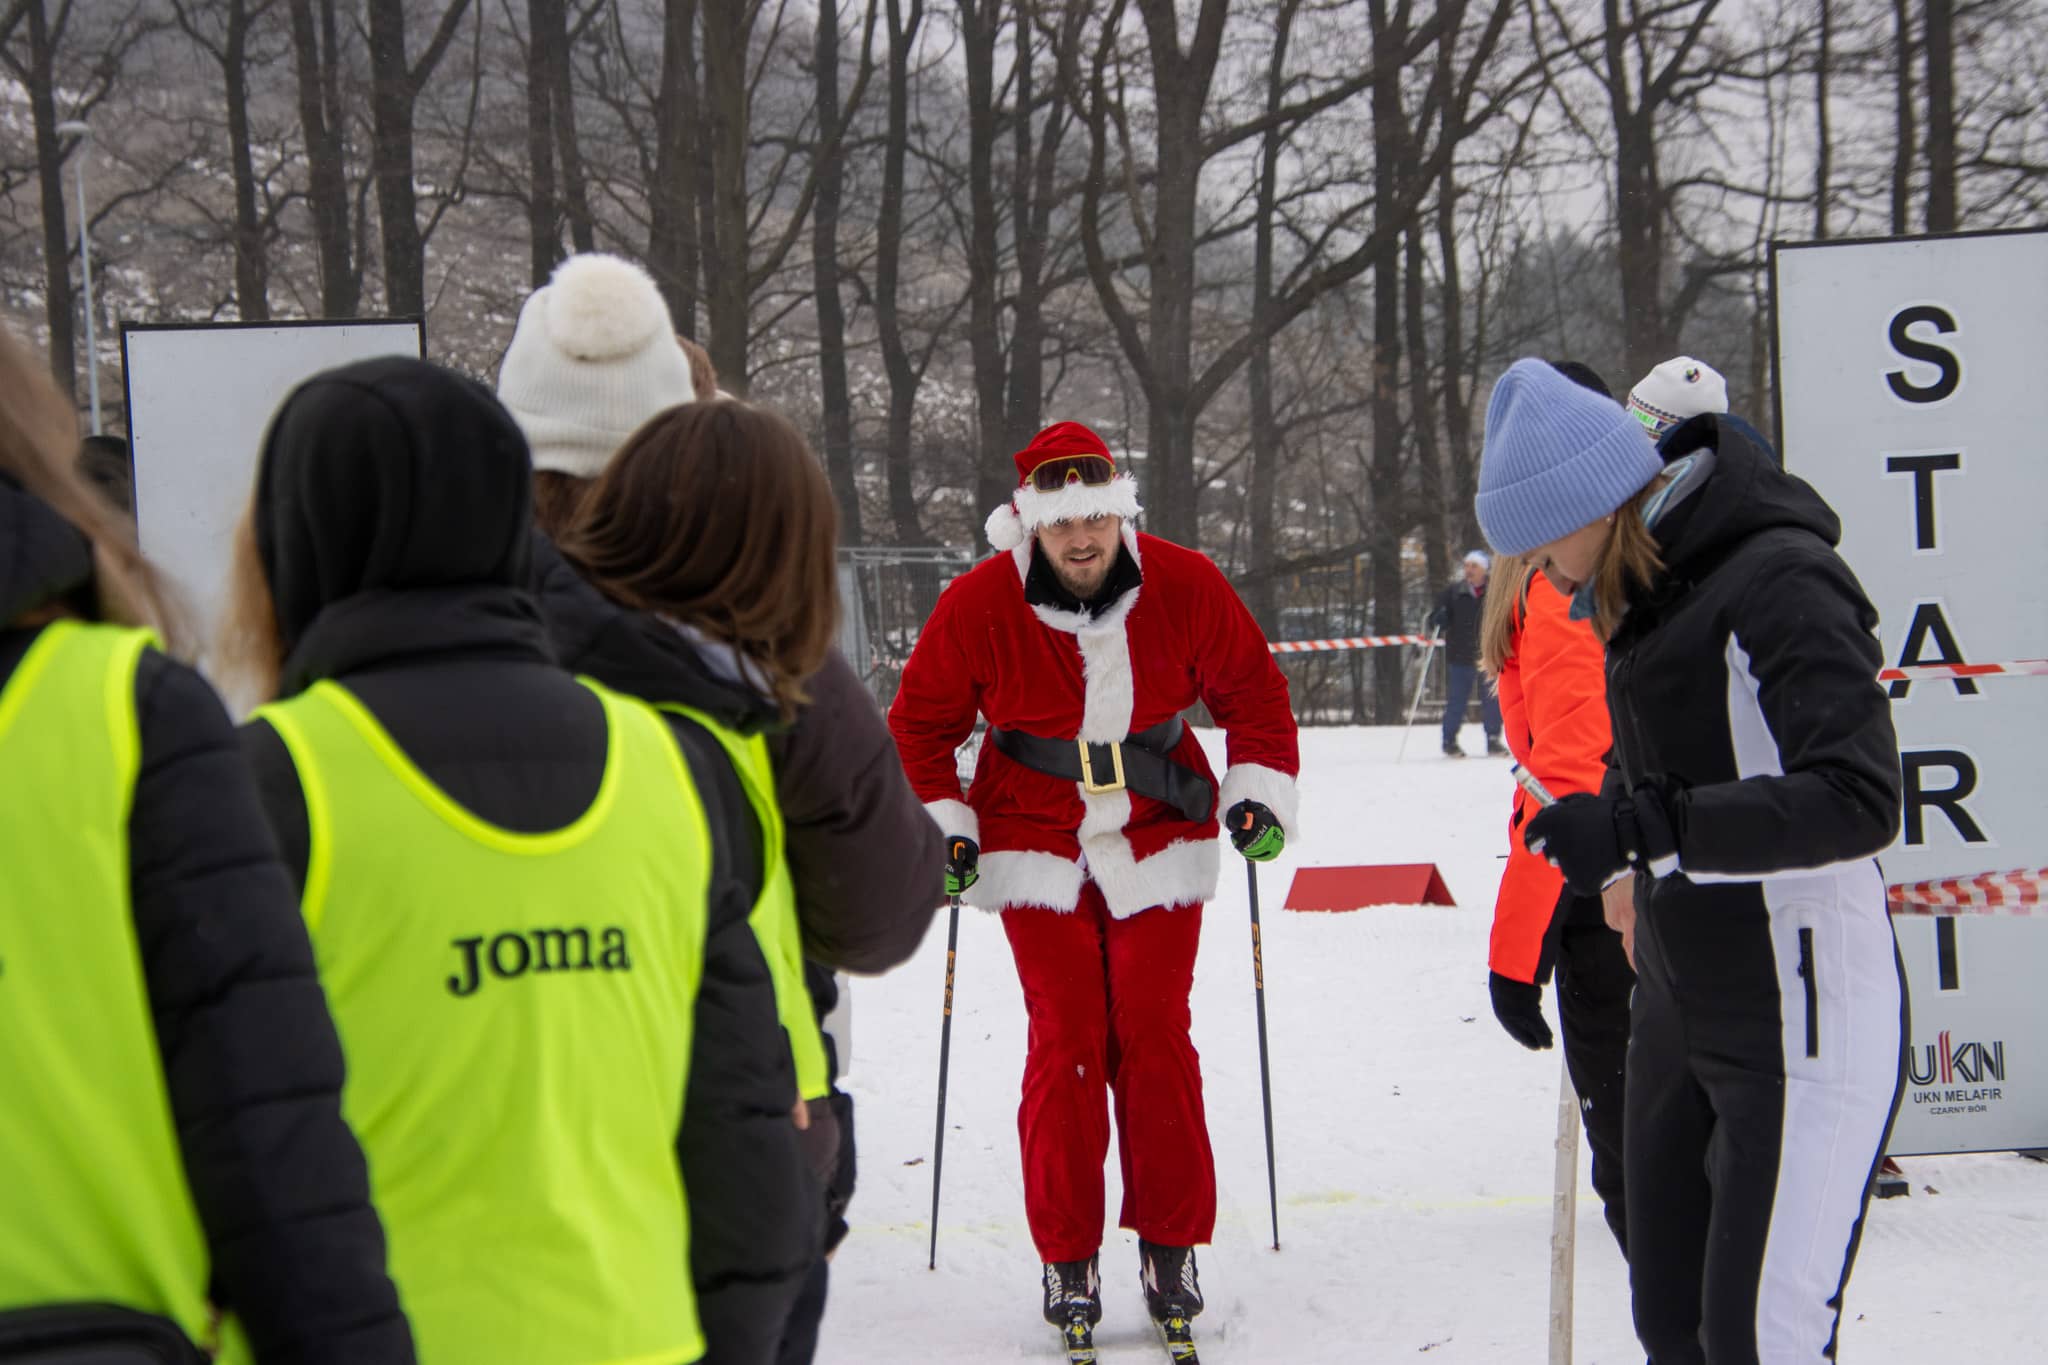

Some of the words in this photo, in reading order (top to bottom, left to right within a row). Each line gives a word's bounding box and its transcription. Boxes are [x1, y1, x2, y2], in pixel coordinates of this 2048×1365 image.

[1913, 1091, 1941, 1104] UKN
[1945, 1088, 2003, 1103] MELAFIR
[1930, 1106, 1966, 1115] CZARNY
[1968, 1104, 1987, 1113] BÓR
